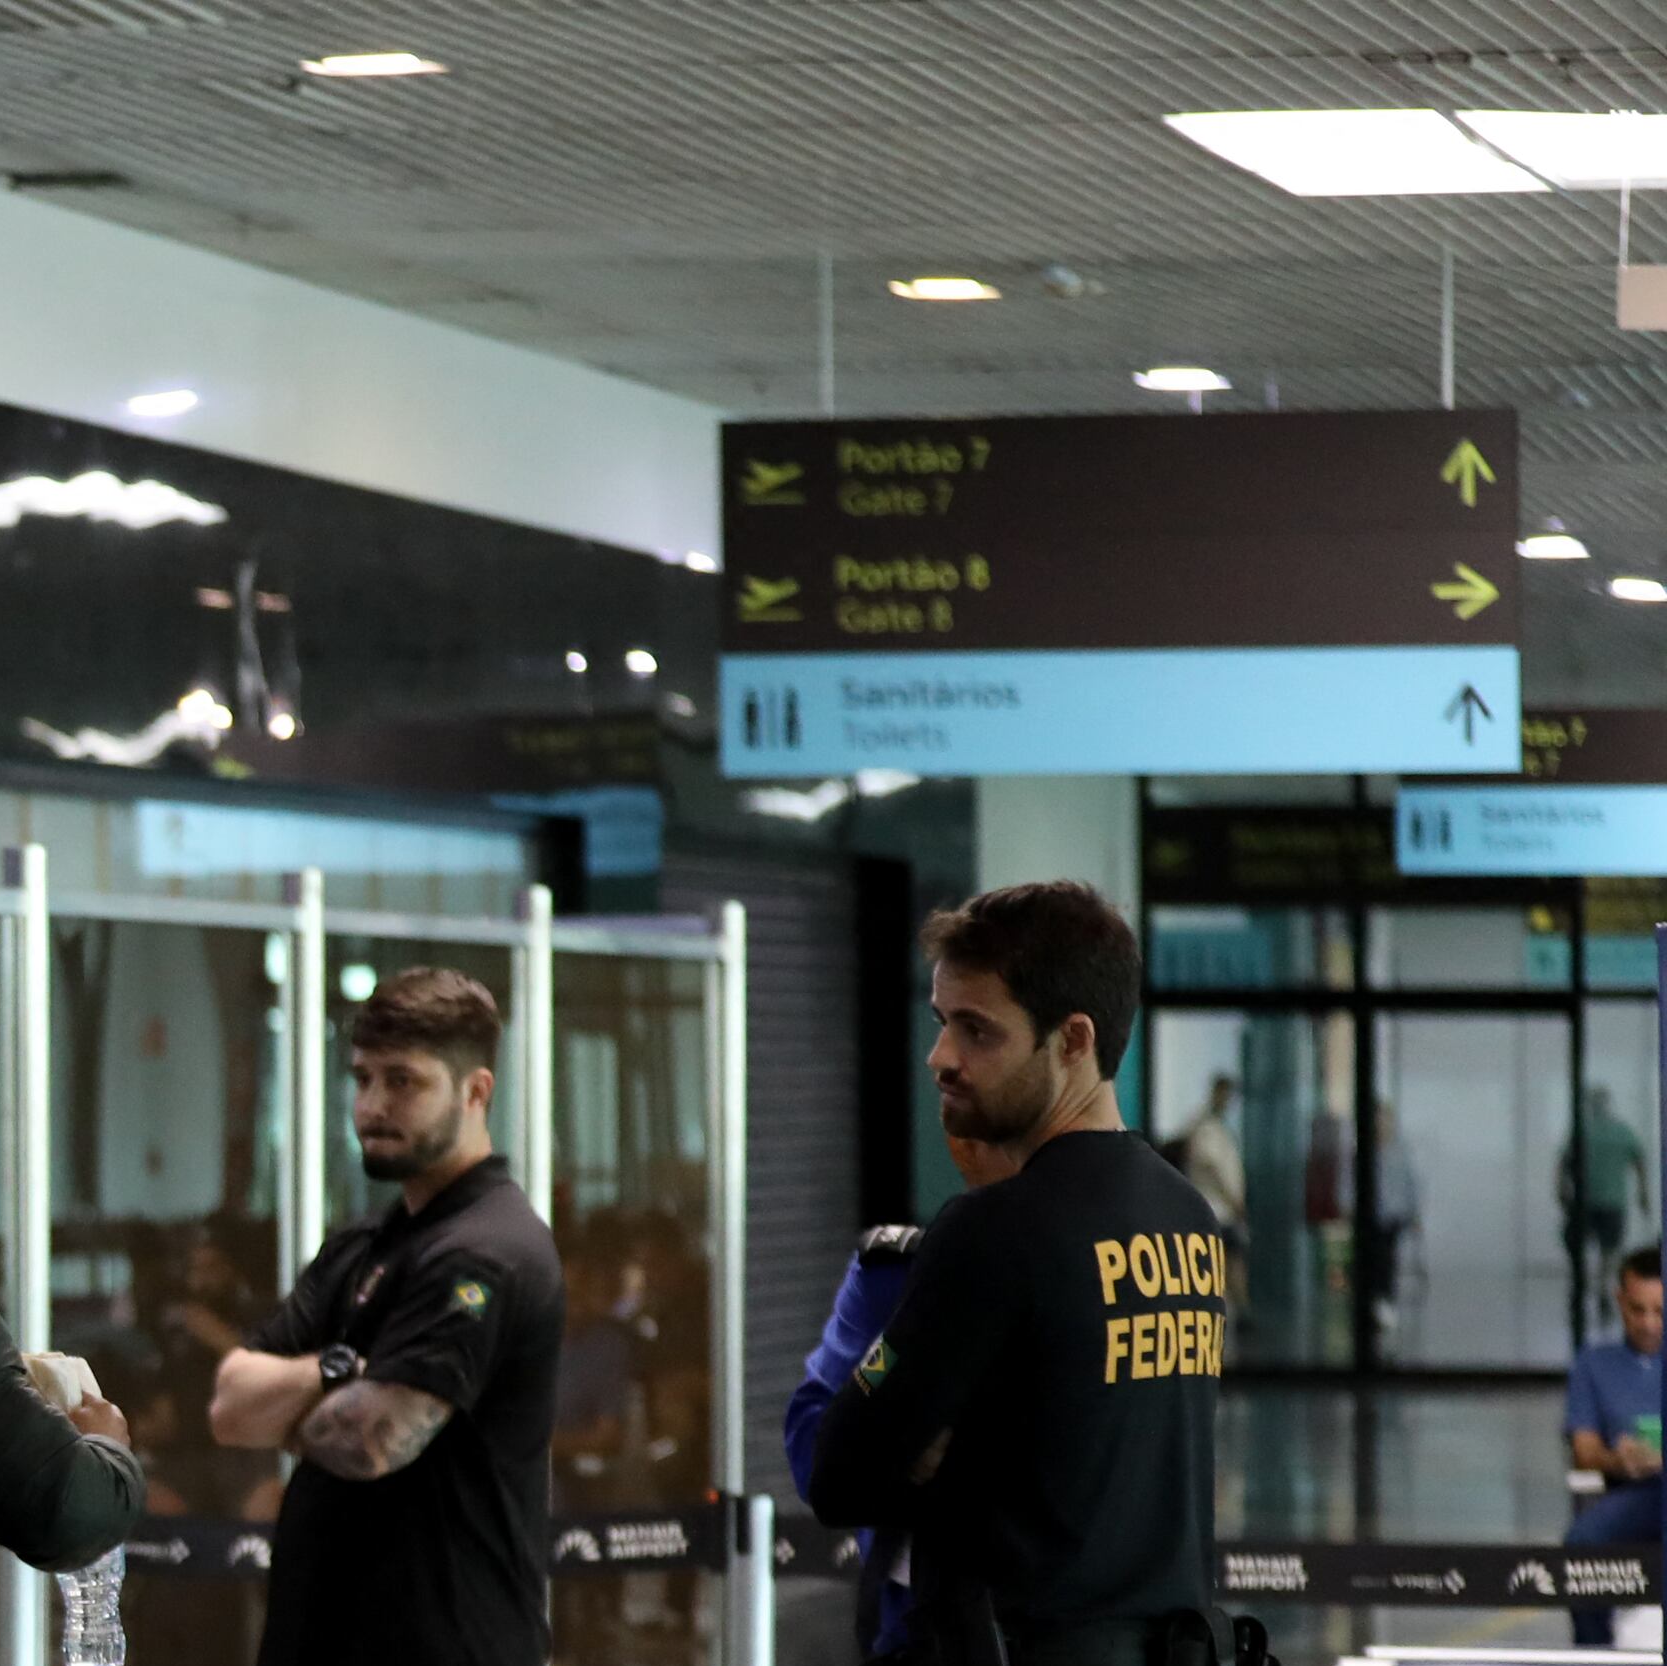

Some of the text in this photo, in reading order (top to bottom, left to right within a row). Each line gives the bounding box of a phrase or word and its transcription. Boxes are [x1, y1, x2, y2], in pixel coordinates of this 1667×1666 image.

[837, 435, 991, 474] Portão 7
[838, 480, 927, 516] Gate
[834, 554, 961, 592] Portão
[835, 598, 925, 634] Gate
[842, 674, 1020, 710] Sanitários
[1094, 1233, 1226, 1305] POLICI
[1224, 1571, 1309, 1592] AIRPORT
[1565, 1574, 1649, 1596] AIRPORT
